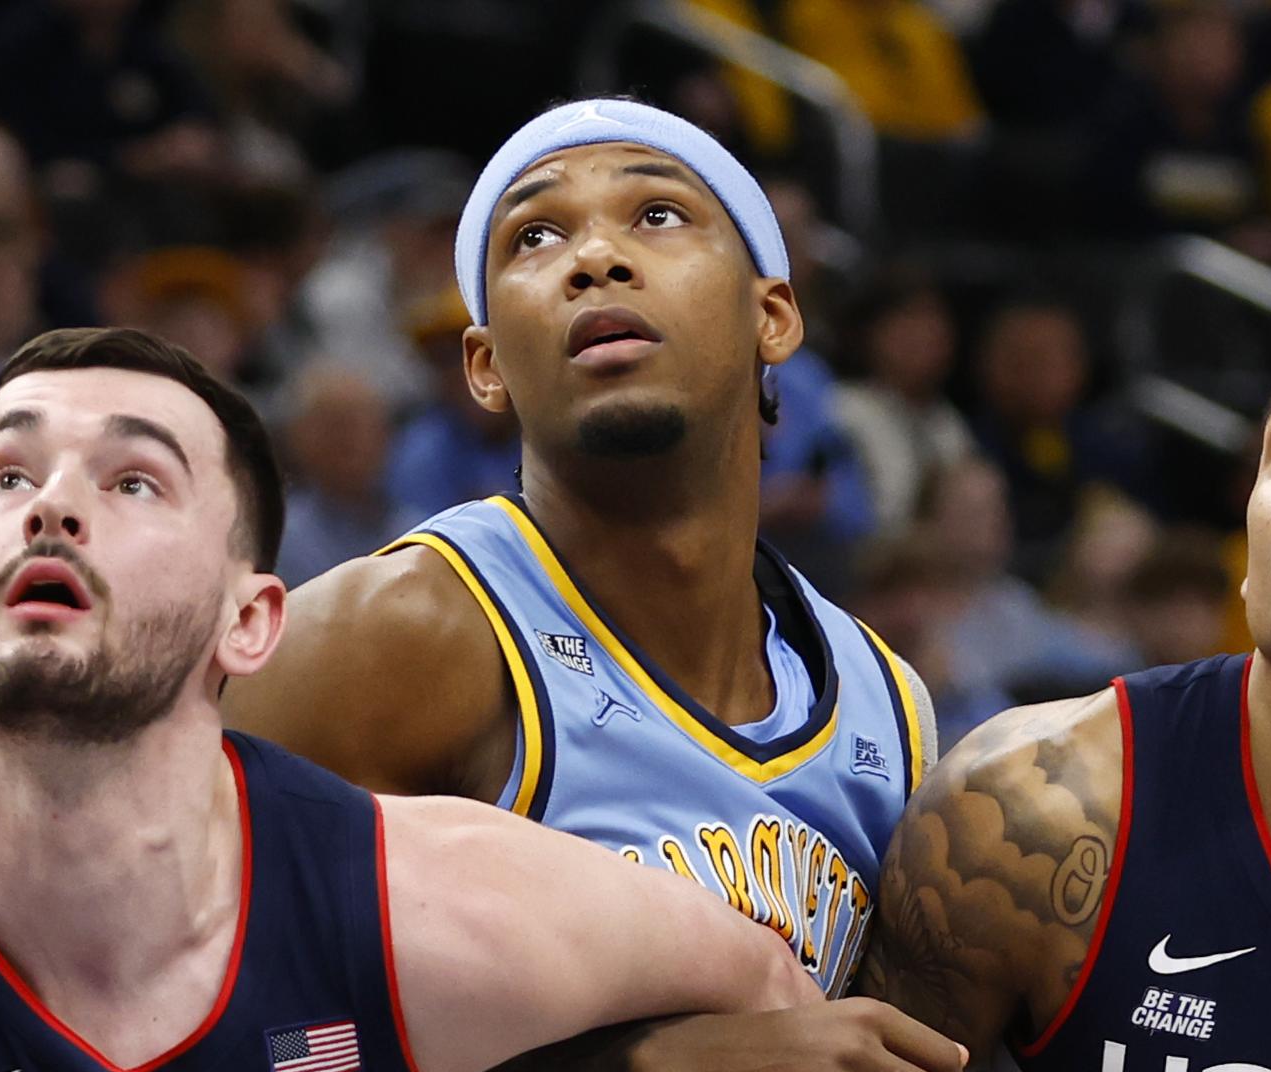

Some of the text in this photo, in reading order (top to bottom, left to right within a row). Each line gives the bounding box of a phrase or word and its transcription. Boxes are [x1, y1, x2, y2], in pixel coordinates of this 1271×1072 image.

[554, 636, 586, 656] THE
[856, 737, 877, 754] BIG
[856, 750, 888, 769] EAST
[1142, 989, 1217, 1019] BE THE
[1131, 1006, 1216, 1039] CHANGE
